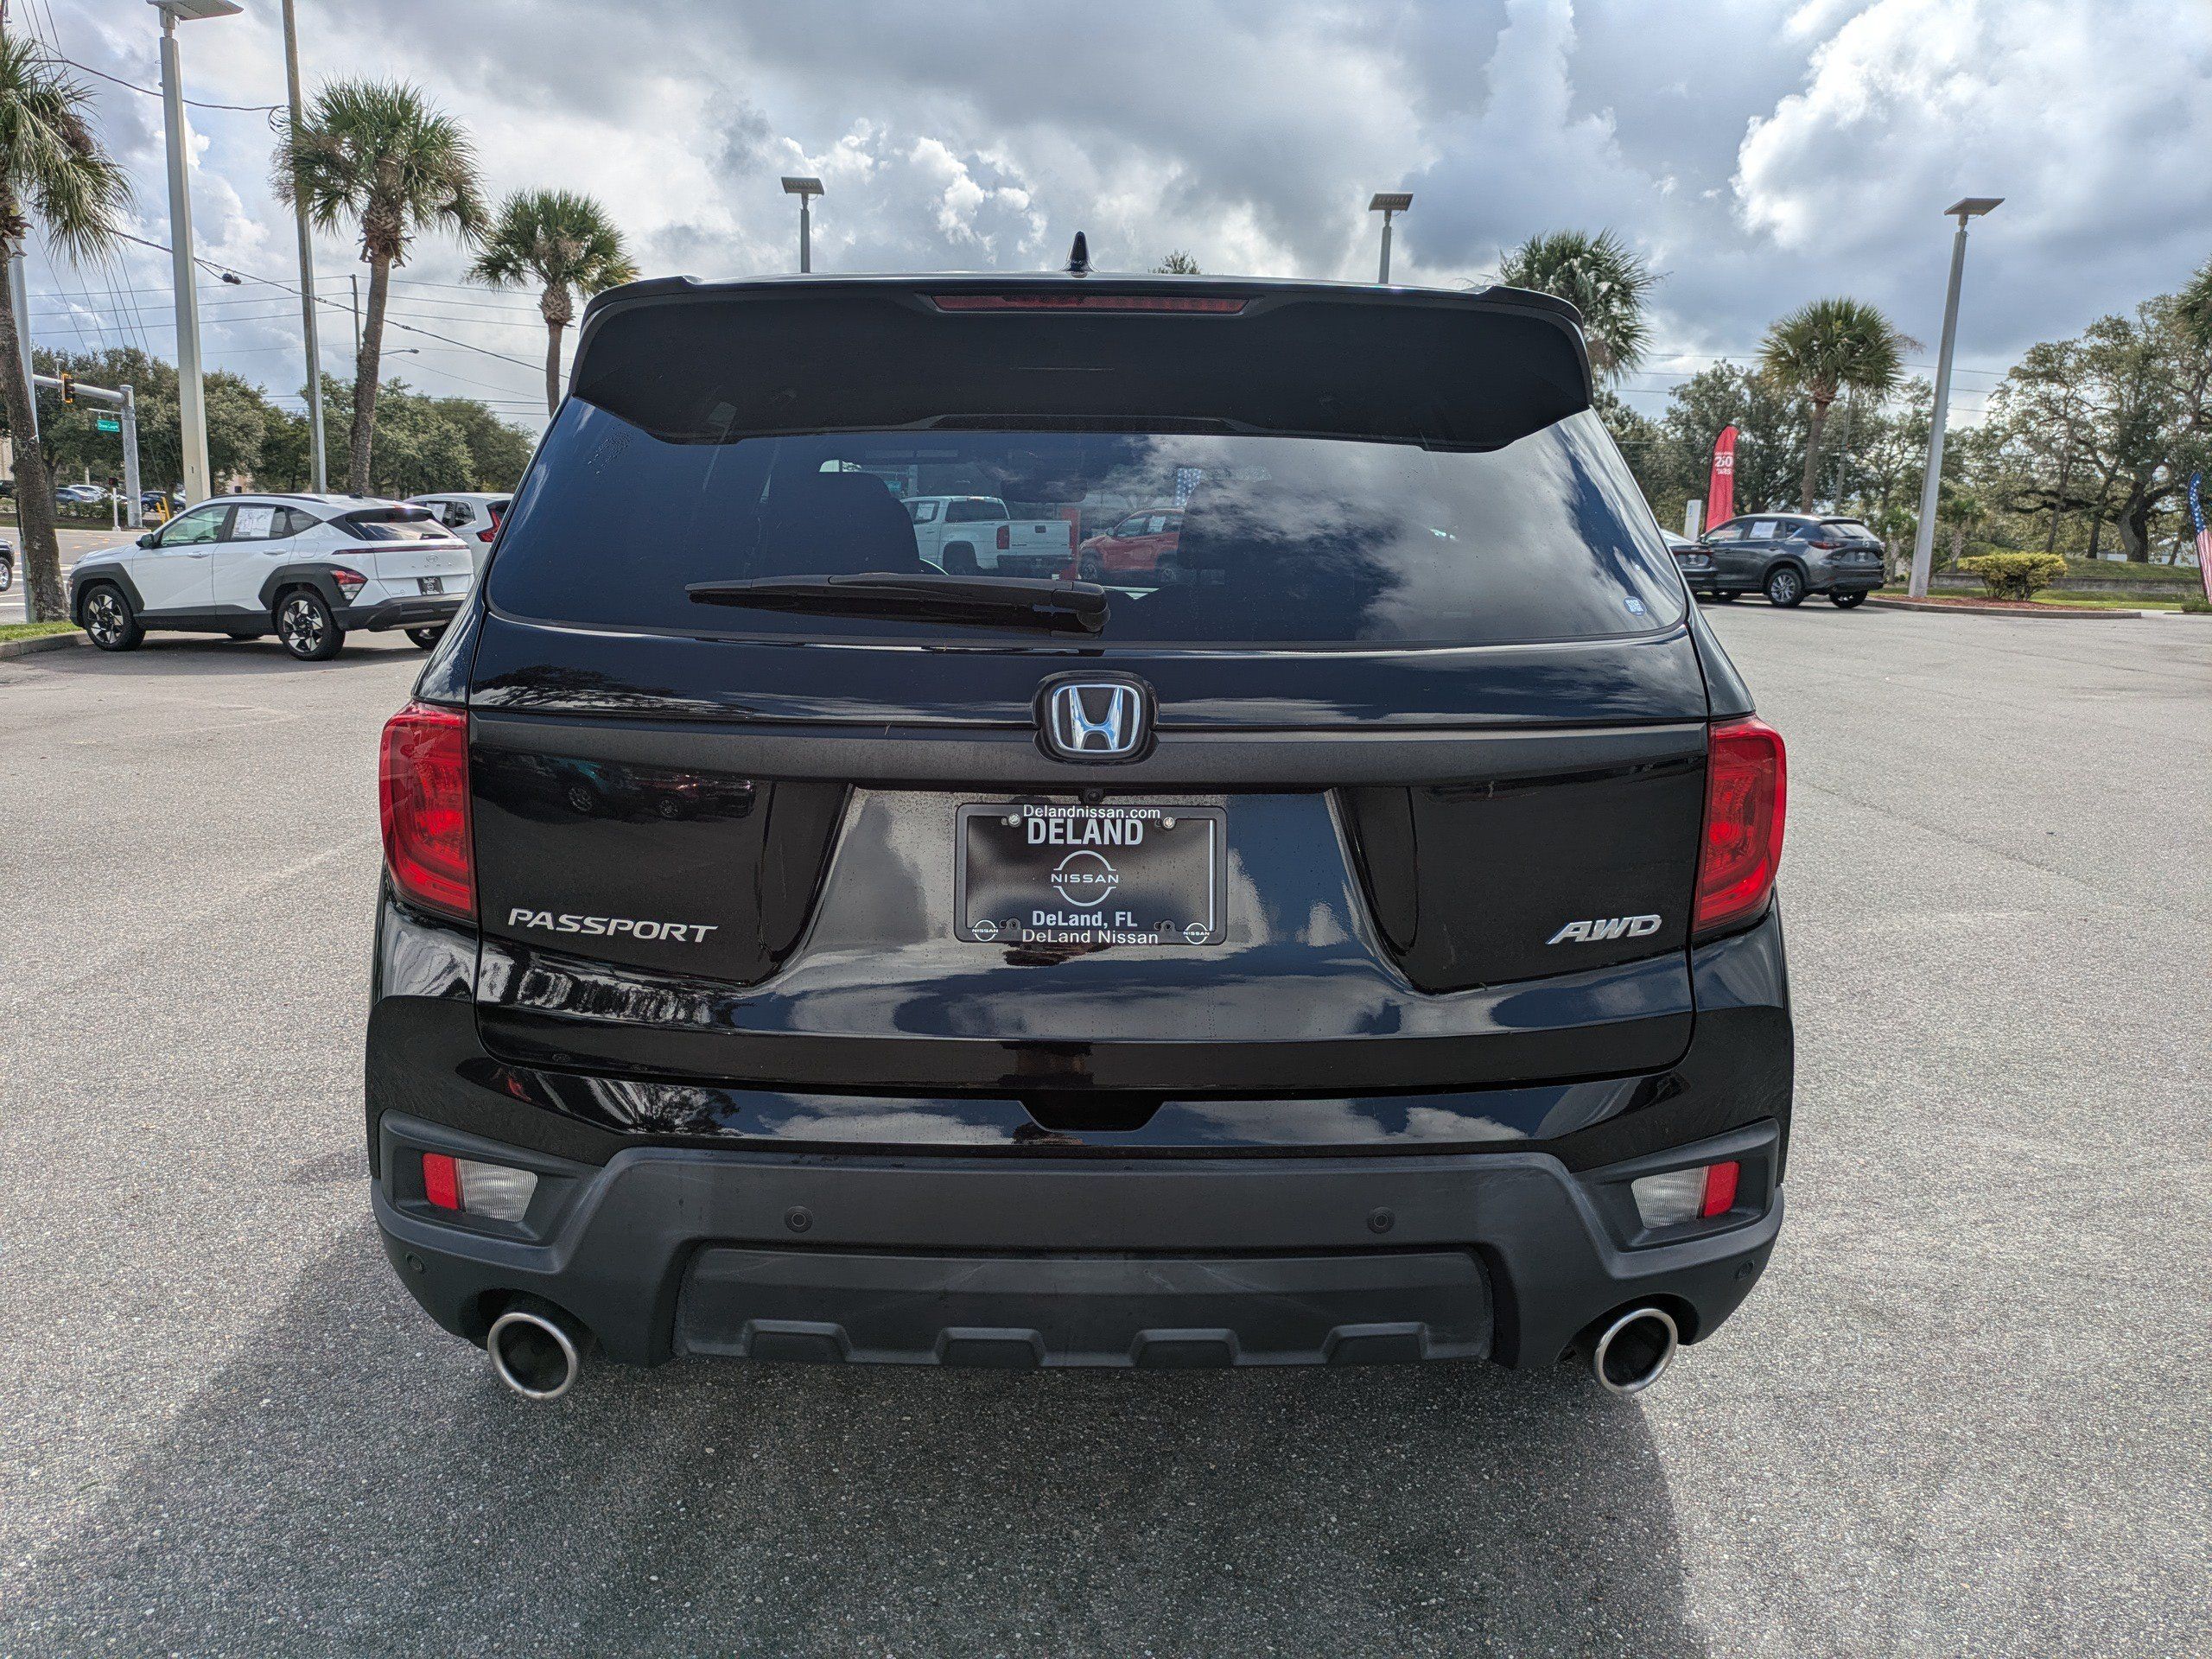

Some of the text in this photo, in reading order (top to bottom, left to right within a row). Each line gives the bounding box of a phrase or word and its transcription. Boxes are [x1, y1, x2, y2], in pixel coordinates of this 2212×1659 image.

[1714, 455, 1733, 467] 20
[1023, 804, 1161, 820] Delandnissan.com
[1027, 818, 1143, 845] DELAND
[1051, 873, 1119, 883] NISSAN
[508, 907, 719, 944] PASSPORT
[1032, 911, 1138, 929] DeLand, FL
[1022, 929, 1159, 944] DeLand Nissan
[1546, 914, 1662, 944] AWD
